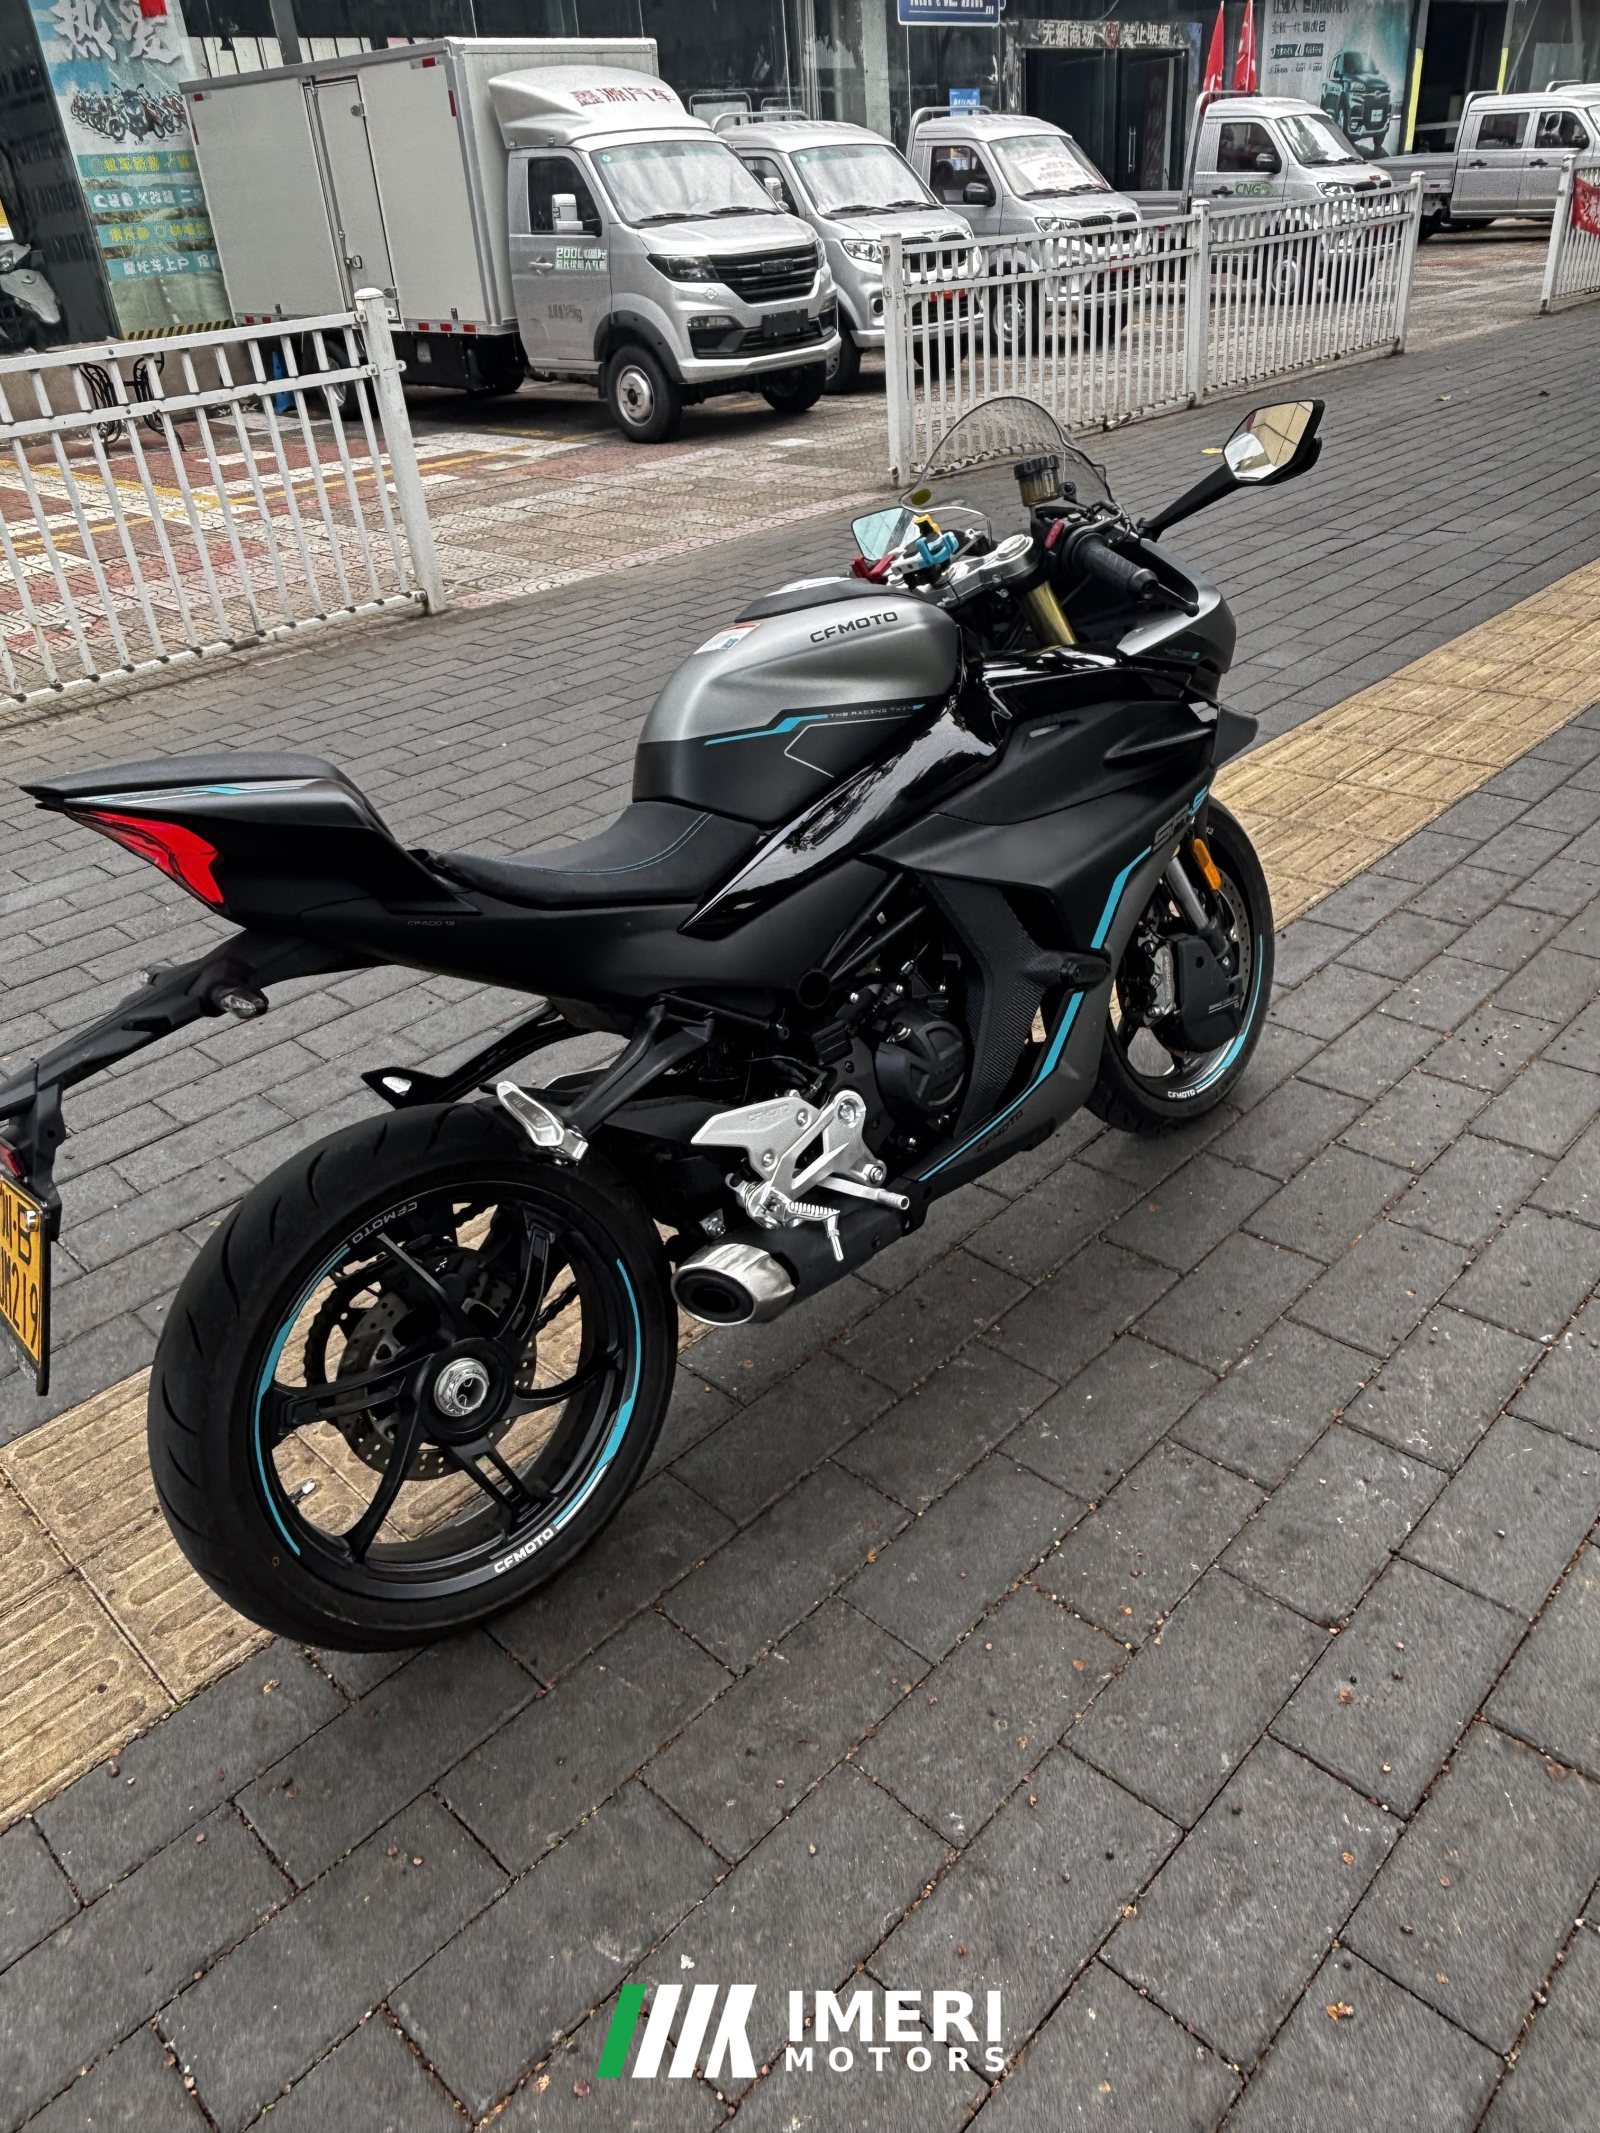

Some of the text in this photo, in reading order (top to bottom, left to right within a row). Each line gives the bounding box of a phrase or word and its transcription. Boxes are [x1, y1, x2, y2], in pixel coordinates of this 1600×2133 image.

[1041, 22, 1095, 47] 无烟商场
[1119, 22, 1170, 48] 禁止吸烟
[809, 611, 898, 643] CFMOTO
[1167, 1088, 1196, 1099] CFMOTO
[351, 1201, 419, 1245] CFMOTO
[493, 1527, 554, 1574] CFMOTO
